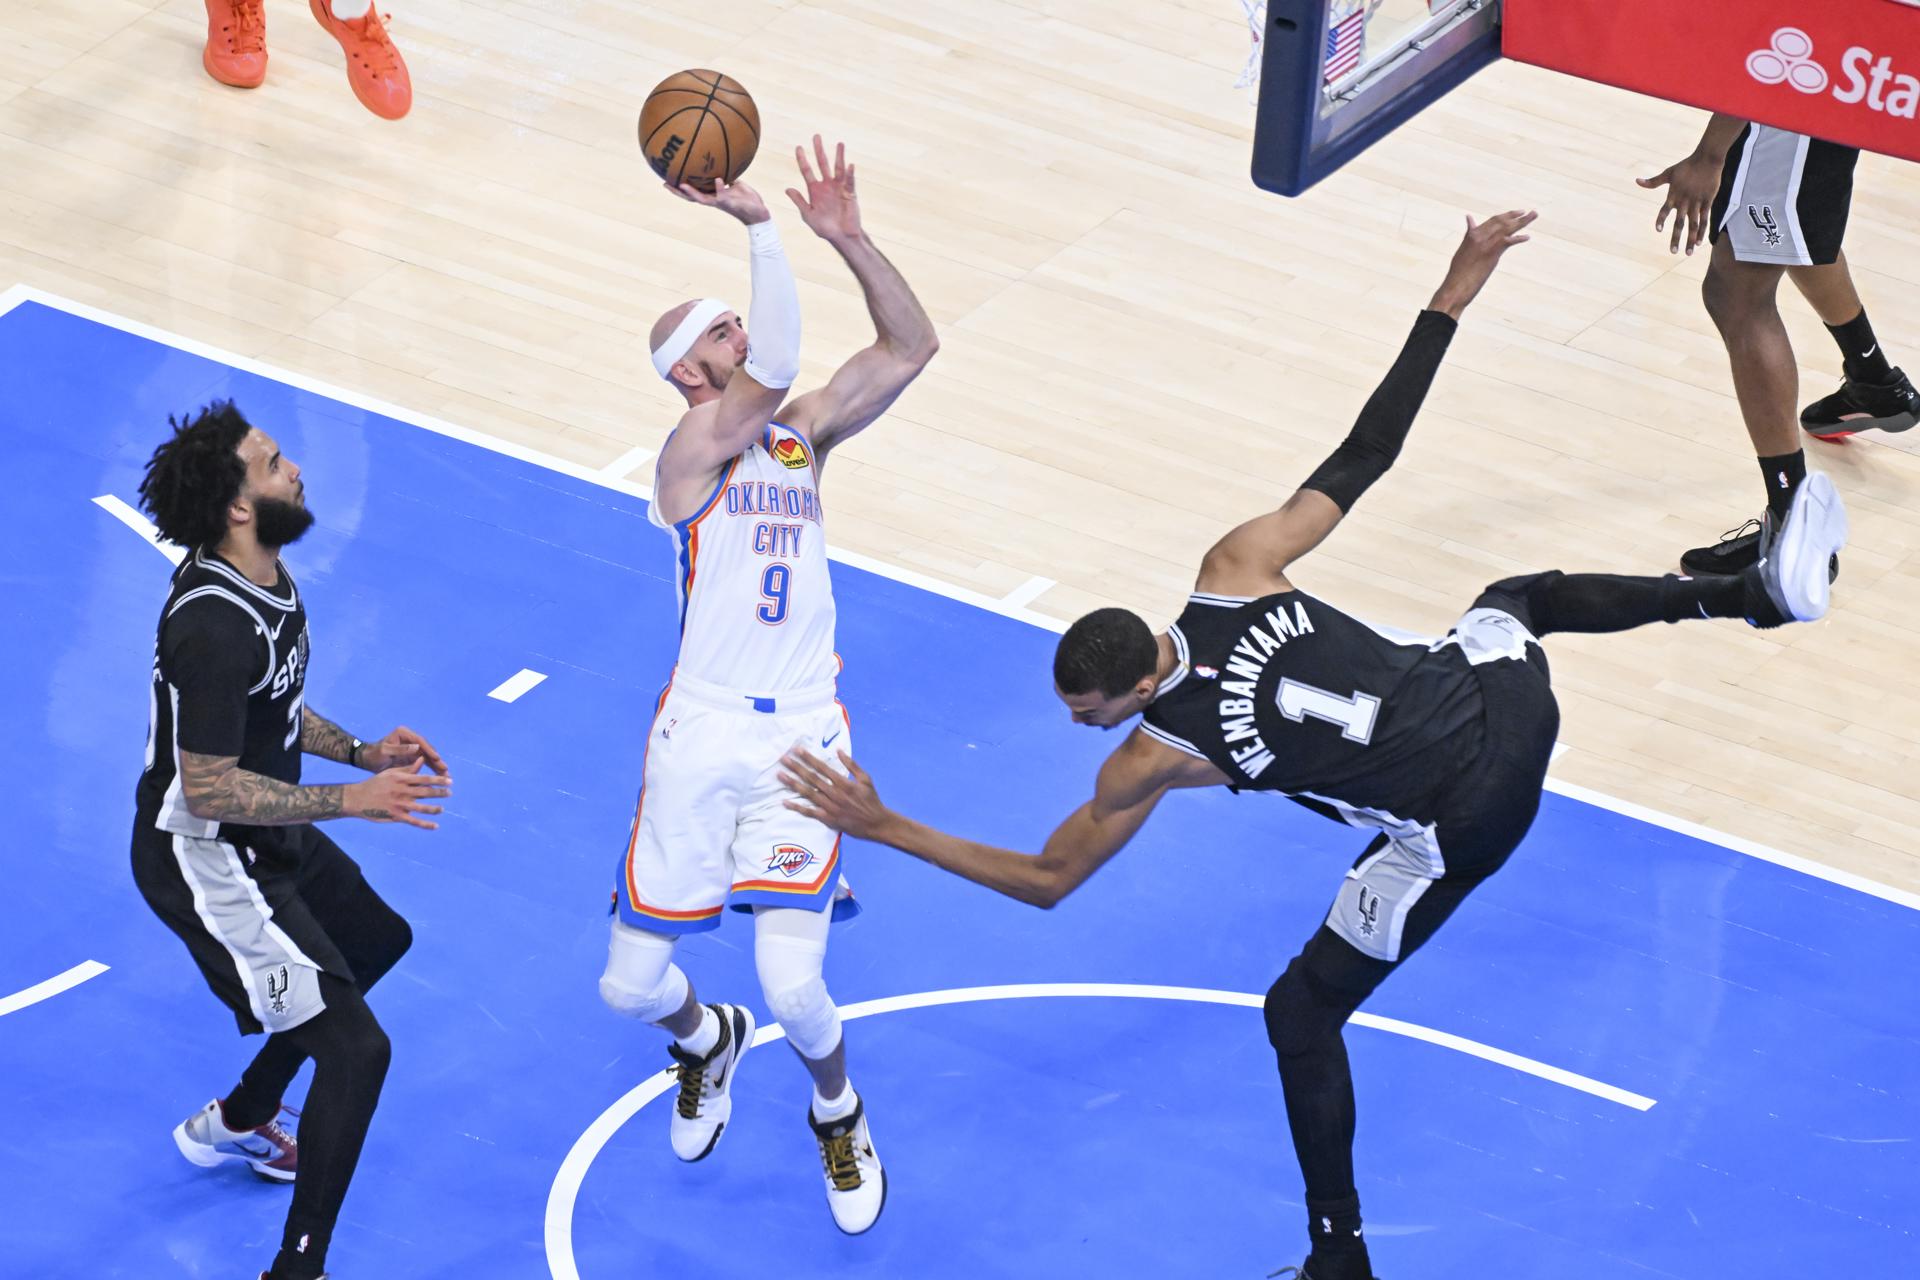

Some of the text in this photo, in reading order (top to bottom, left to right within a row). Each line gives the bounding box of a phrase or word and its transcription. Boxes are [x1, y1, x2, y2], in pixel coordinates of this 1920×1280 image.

[726, 482, 821, 526] OKLAOM
[754, 522, 803, 557] CITY
[756, 562, 793, 626] 9
[1220, 601, 1315, 779] WEMBANYAMA
[1275, 676, 1382, 746] 1
